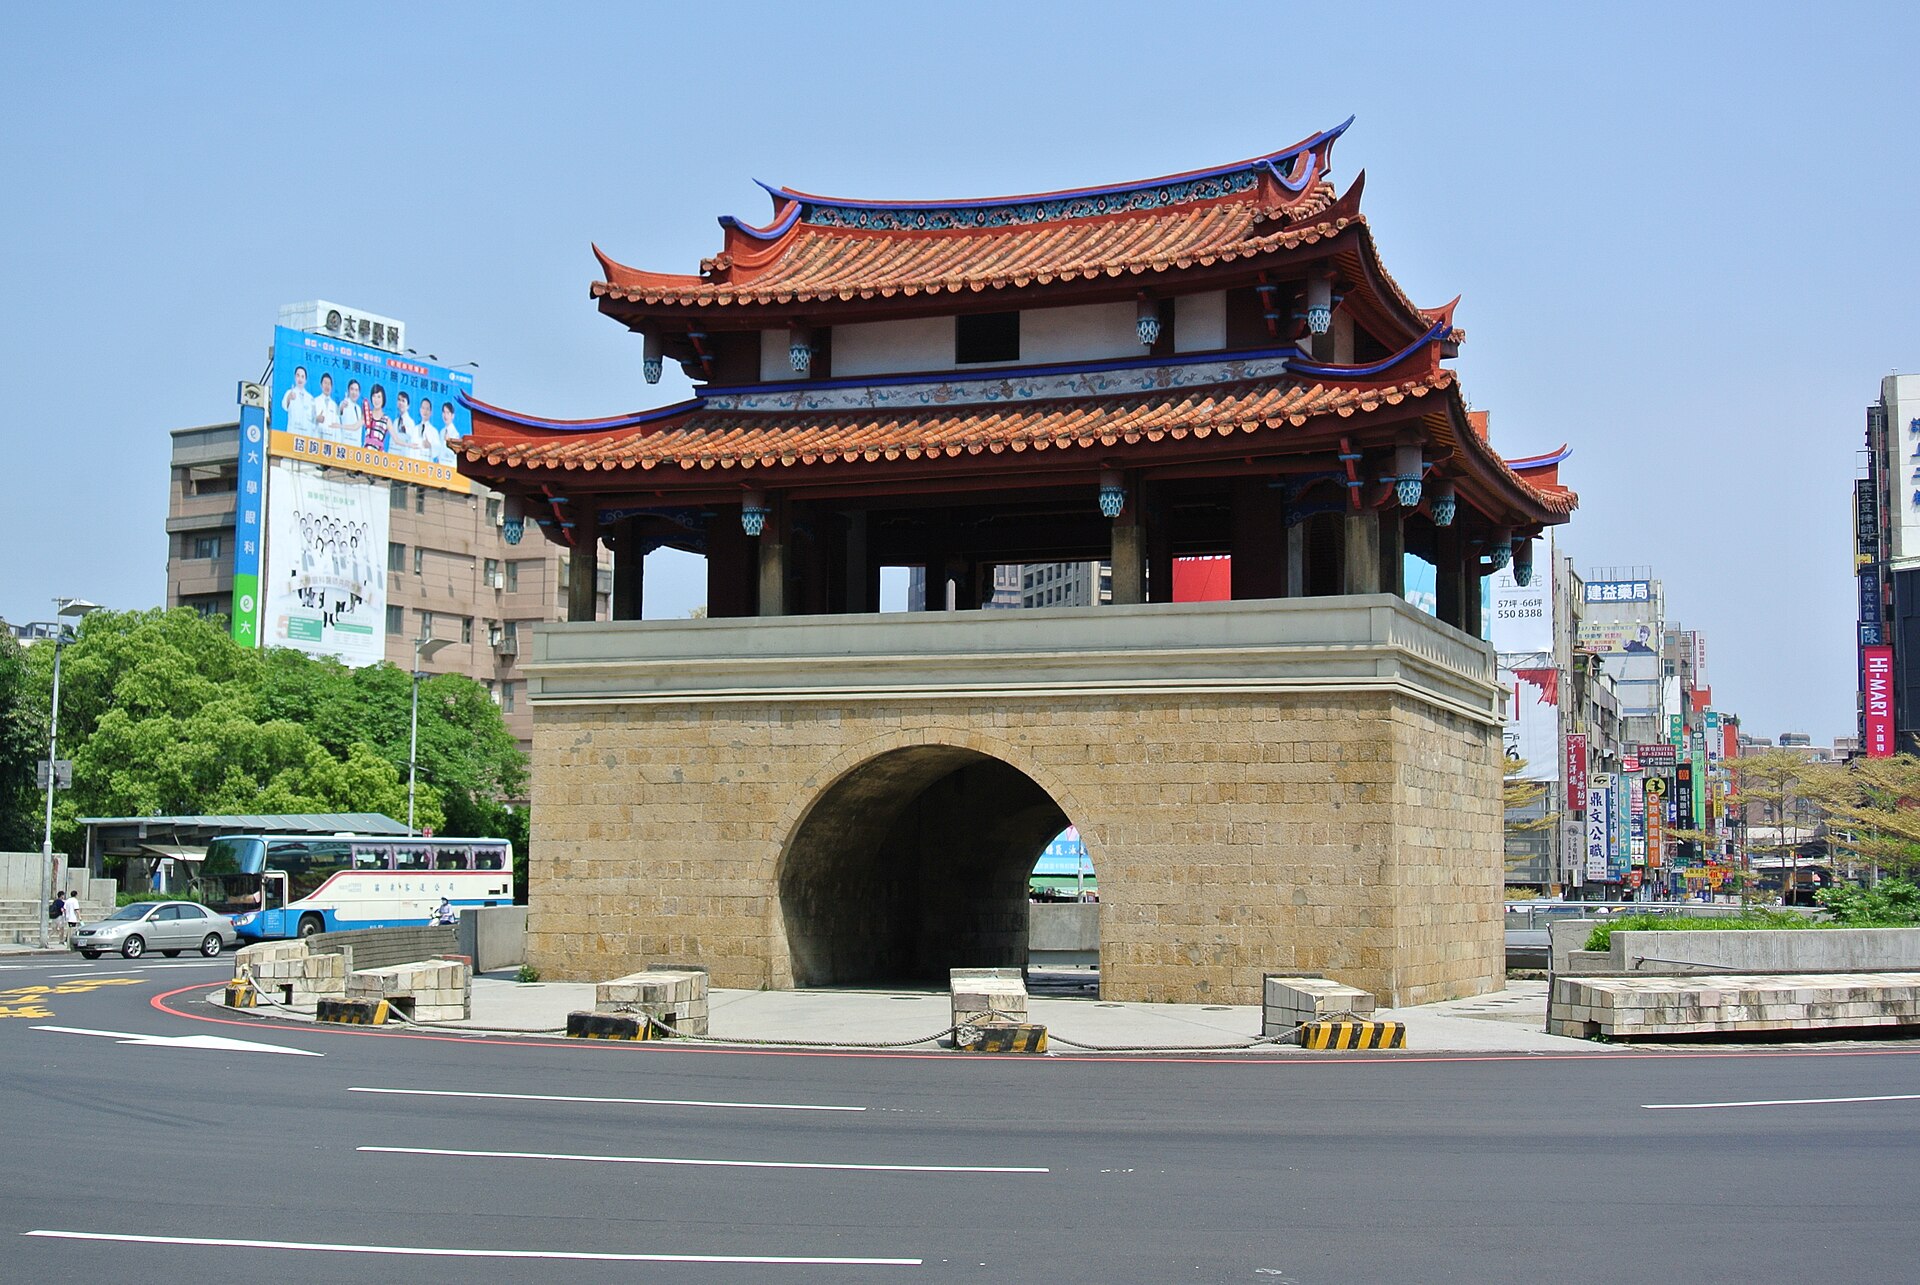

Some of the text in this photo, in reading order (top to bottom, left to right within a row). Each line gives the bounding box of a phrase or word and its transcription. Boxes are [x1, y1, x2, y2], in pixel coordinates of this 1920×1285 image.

[243, 450, 258, 556] 大學眼科
[1587, 584, 1648, 600] 建益藥局
[240, 620, 251, 635] 大
[1498, 608, 1543, 618] 550 8388
[1869, 657, 1888, 717] Hi-MART
[1589, 792, 1605, 858] 鼎文公職
